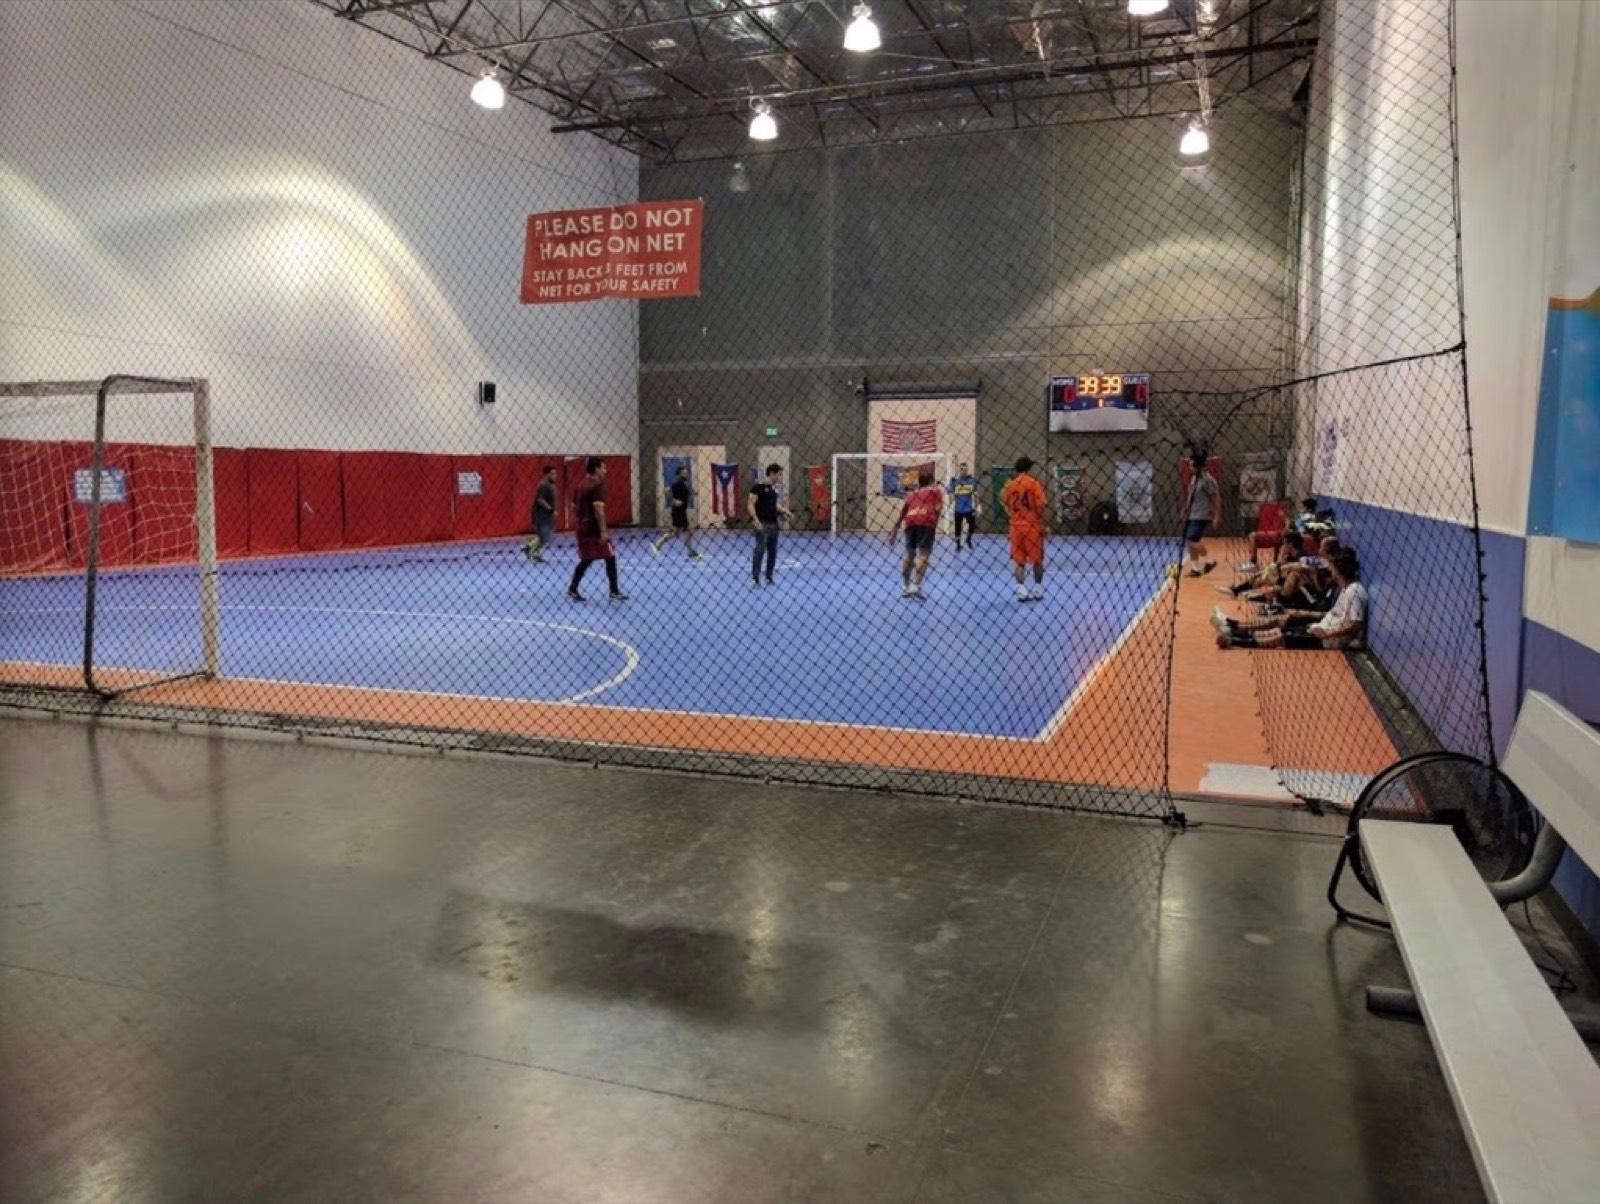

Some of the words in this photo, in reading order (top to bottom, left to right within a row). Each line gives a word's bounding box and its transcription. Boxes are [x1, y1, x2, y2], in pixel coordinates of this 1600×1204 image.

[535, 215, 605, 238] PLEASE
[609, 212, 638, 231] DO
[645, 208, 693, 227] NOT
[539, 239, 601, 260] HANG
[607, 236, 640, 254] ON
[646, 233, 686, 252] NET
[533, 268, 564, 282] STAY
[567, 264, 603, 280] BACK
[615, 262, 646, 277] FEET
[649, 261, 688, 276] FROM
[539, 284, 563, 298] NET
[566, 283, 592, 296] FOR
[595, 279, 628, 293] YOUR
[631, 277, 680, 291] SAFETY
